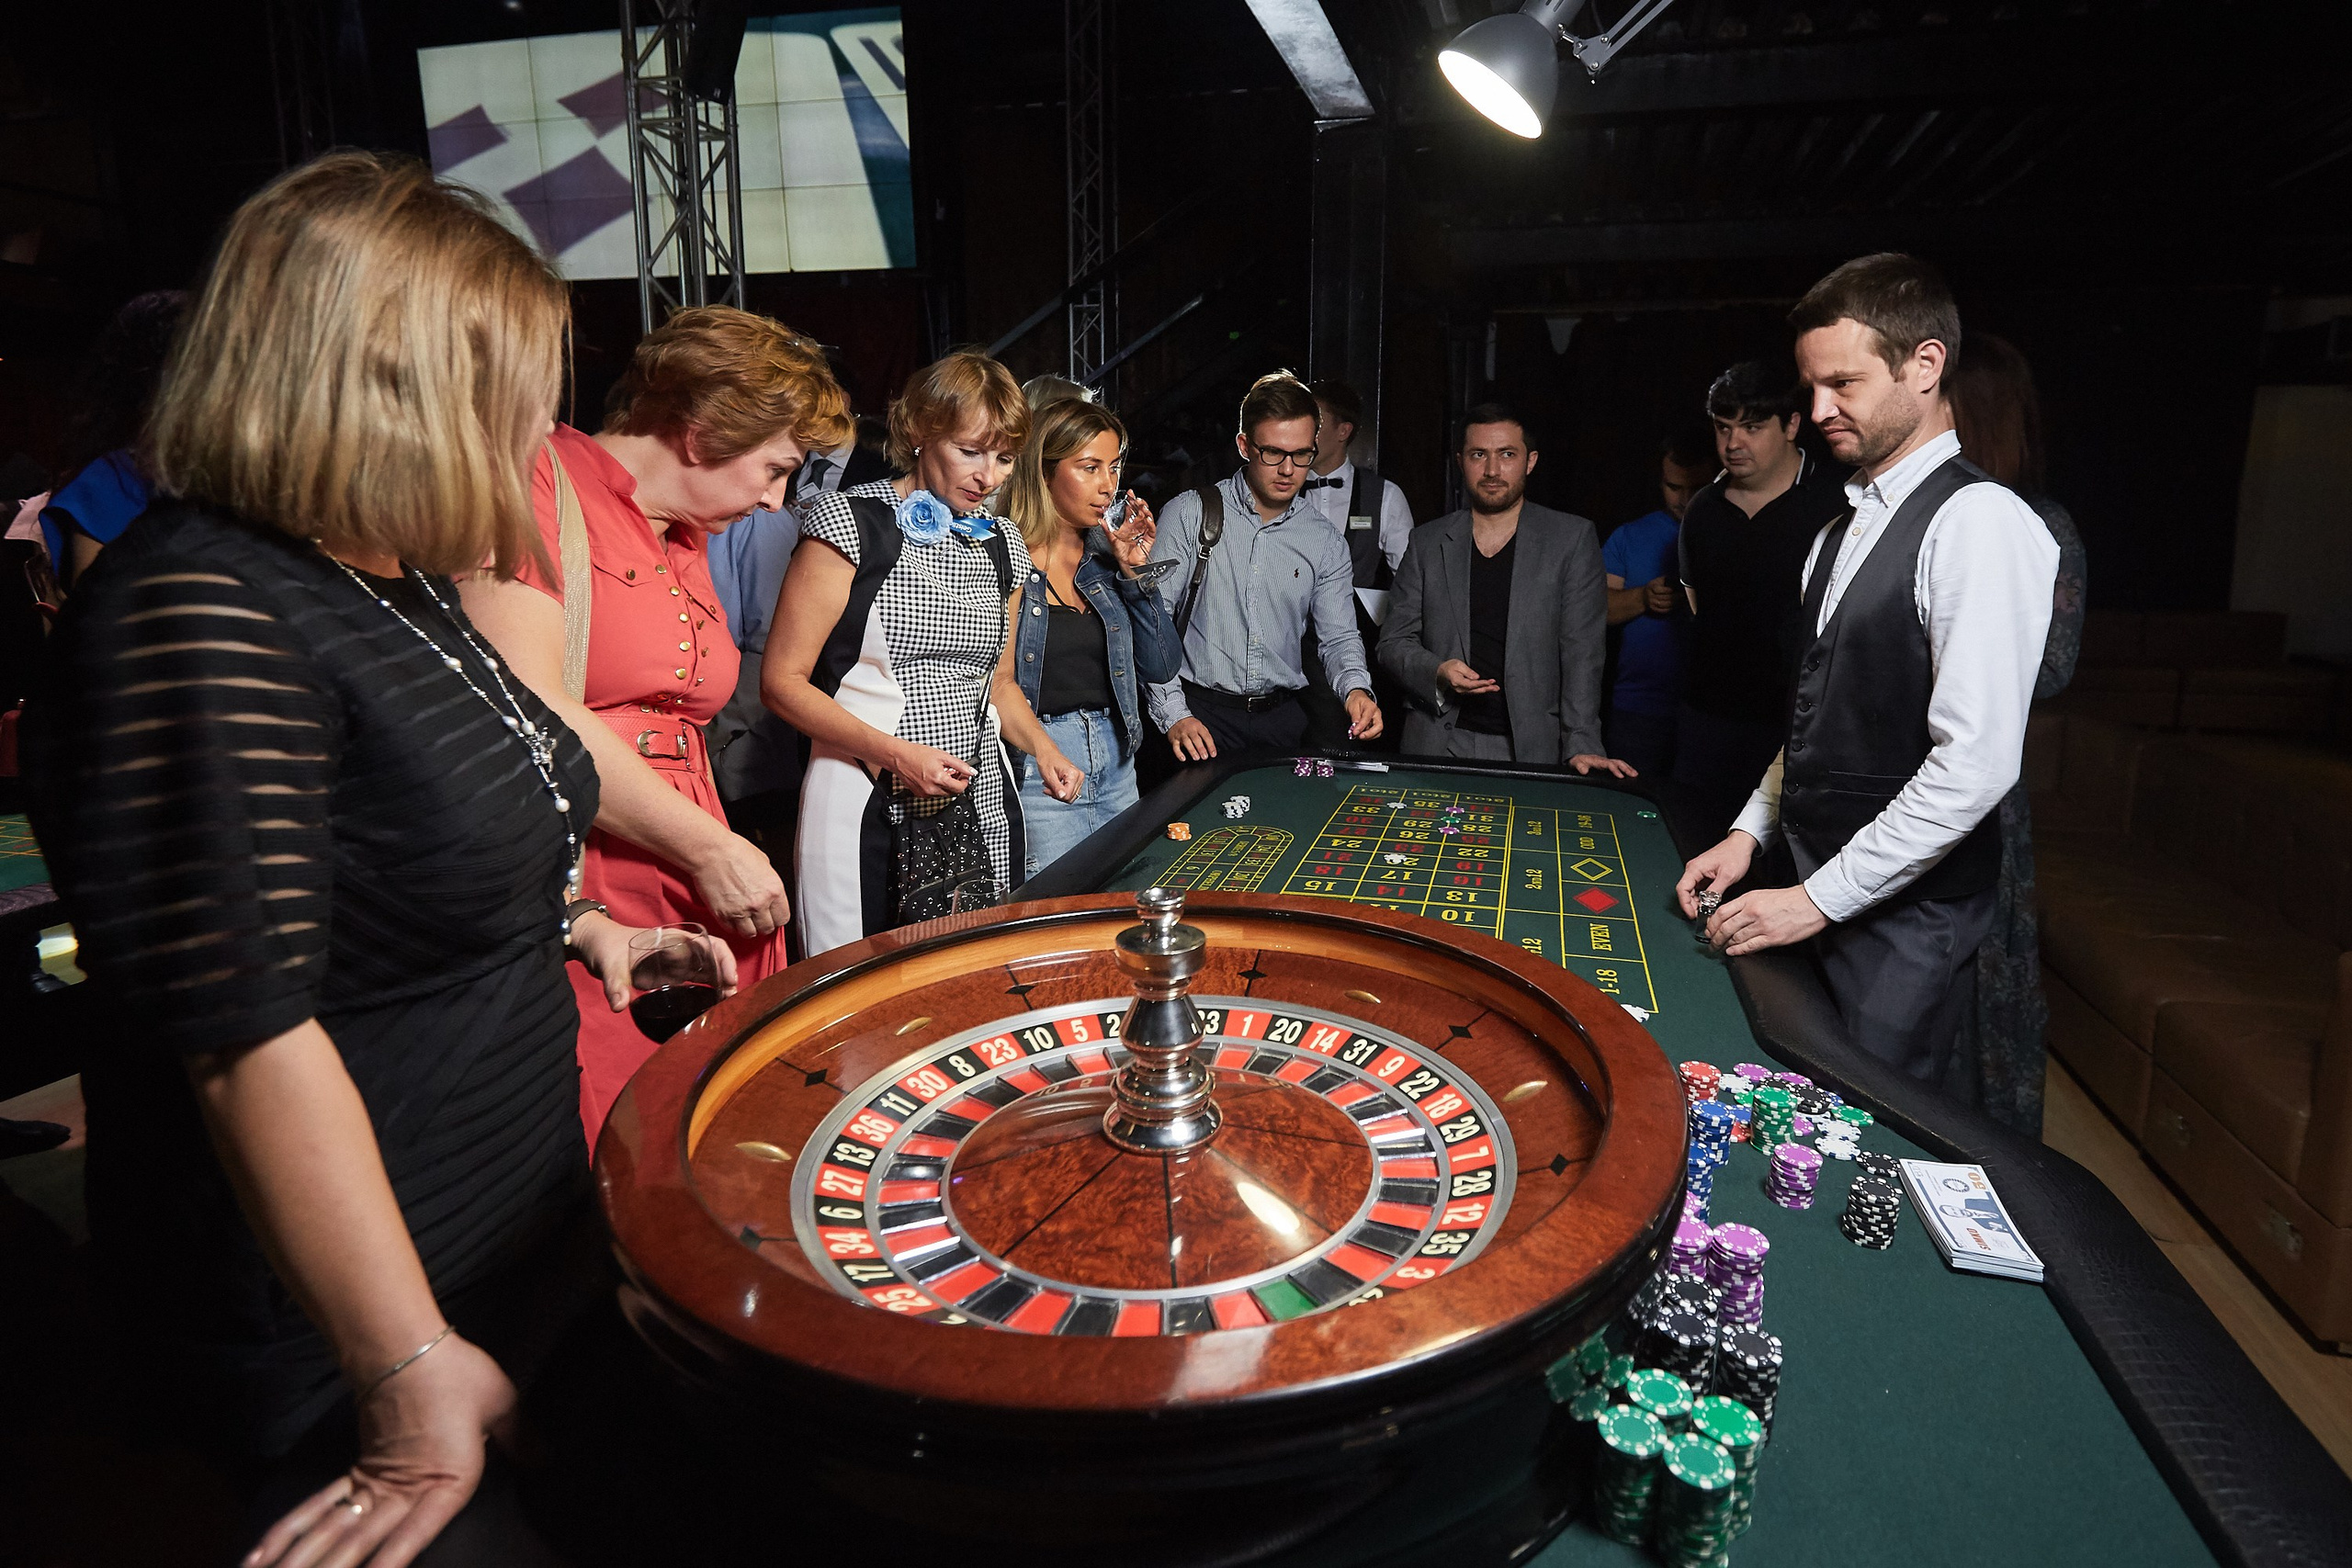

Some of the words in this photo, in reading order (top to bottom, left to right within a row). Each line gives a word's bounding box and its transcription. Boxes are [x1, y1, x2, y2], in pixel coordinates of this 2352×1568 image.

[1399, 831, 1430, 840] 26
[1403, 820, 1433, 828] 29
[1462, 824, 1492, 833] 28
[1331, 839, 1363, 848] 24
[1457, 848, 1489, 858] 22
[1579, 836, 1595, 850] ODD
[1314, 865, 1346, 875] 18
[1380, 870, 1413, 881] 17
[1456, 861, 1485, 871] 19
[1304, 880, 1337, 891] 15
[1377, 885, 1407, 897] 14
[1454, 876, 1483, 886] 16
[1446, 890, 1478, 902] 13
[1441, 909, 1476, 922] 10
[1589, 923, 1612, 952] EVEN
[1596, 968, 1620, 994] 1-18
[1074, 1019, 1088, 1043] 5
[1106, 1014, 1121, 1037] 2
[1243, 1014, 1254, 1037] 1
[1275, 1018, 1303, 1044] 20
[1022, 1025, 1055, 1051] 10
[1309, 1027, 1336, 1053] 14
[980, 1037, 1019, 1066] 23
[1342, 1038, 1378, 1066] 31
[948, 1054, 977, 1078] 8
[1378, 1055, 1406, 1078] 9
[906, 1071, 949, 1099] 30
[1398, 1072, 1440, 1100] 22
[880, 1091, 918, 1116] 11
[1424, 1092, 1462, 1119] 18
[850, 1115, 895, 1143] 36
[1439, 1115, 1481, 1143] 29
[832, 1142, 876, 1167] 13
[1452, 1145, 1489, 1162] 7
[820, 1169, 865, 1197] 27
[1452, 1170, 1492, 1197] 28
[819, 1205, 863, 1220] 6
[1442, 1203, 1485, 1225] 12
[825, 1232, 875, 1254] 34
[1421, 1232, 1470, 1255] 35
[843, 1263, 896, 1283] 17
[1397, 1266, 1436, 1279] 3
[873, 1288, 933, 1312] 25
